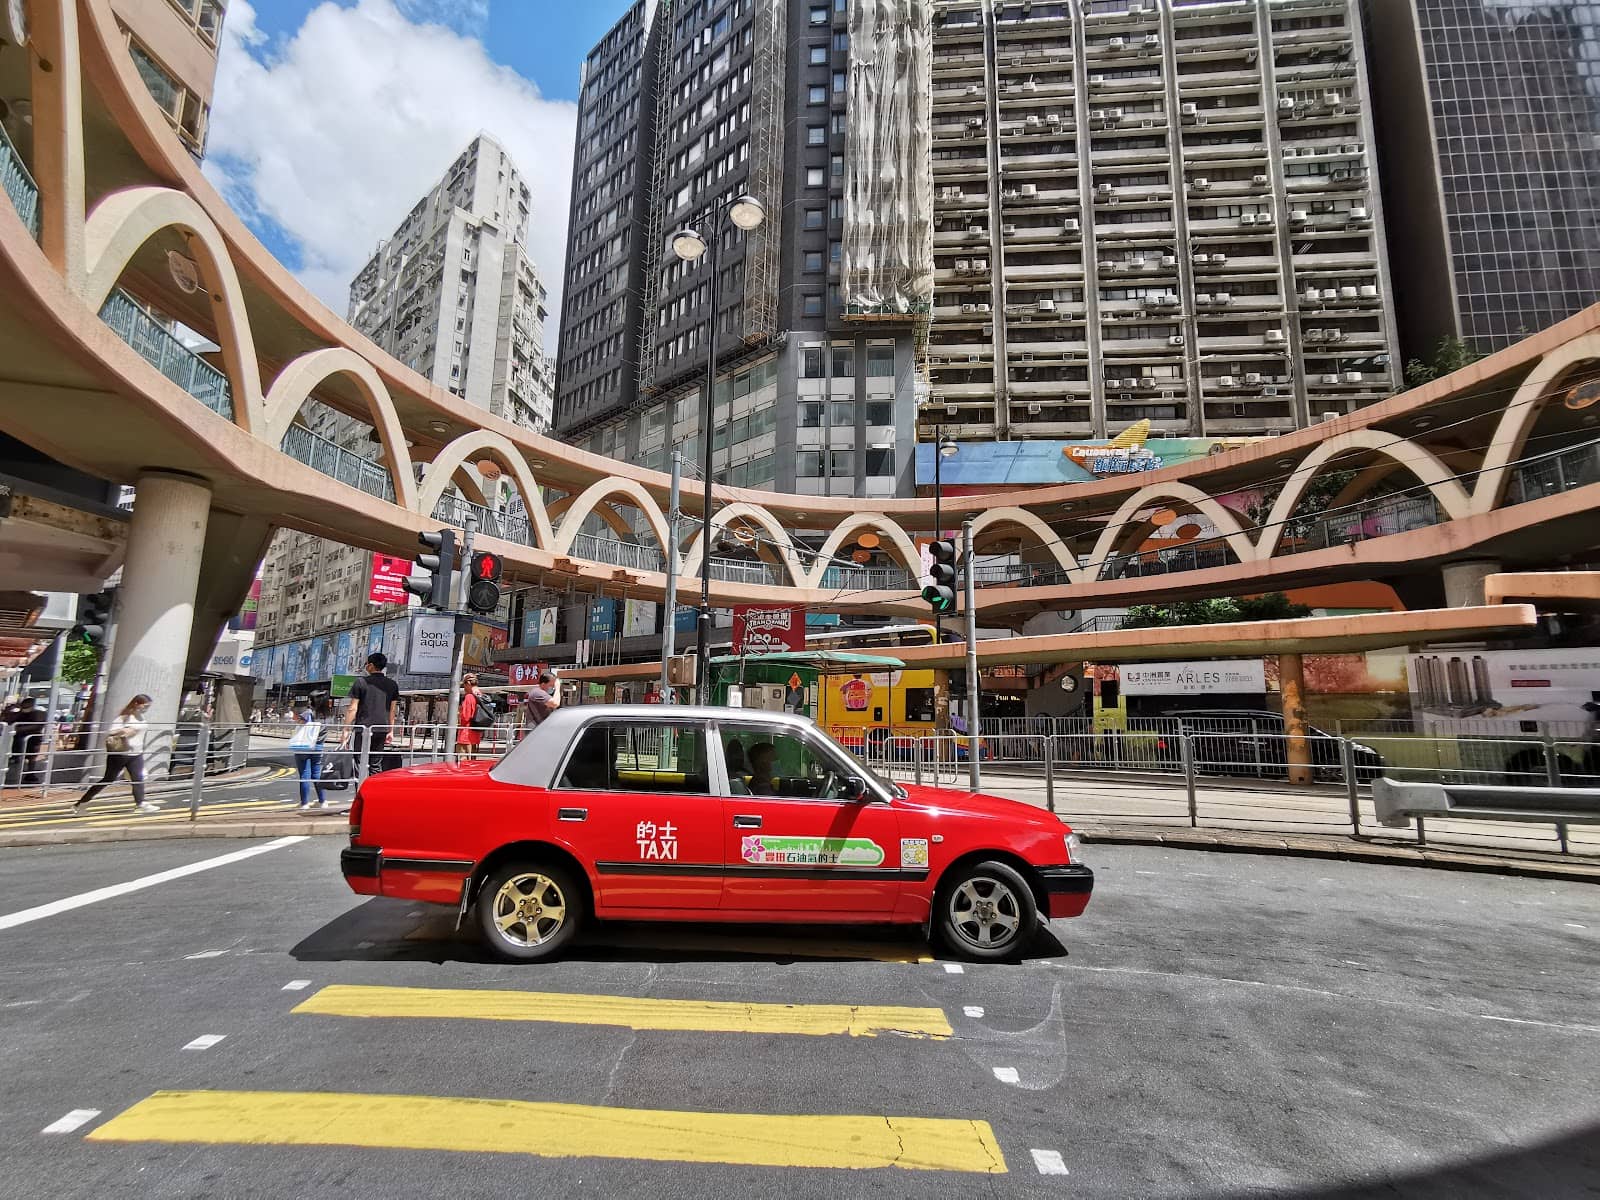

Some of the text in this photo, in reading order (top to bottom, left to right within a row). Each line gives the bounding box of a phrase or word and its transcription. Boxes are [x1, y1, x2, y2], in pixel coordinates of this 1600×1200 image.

[421, 629, 443, 640] bon
[420, 639, 449, 649] aqua
[1176, 671, 1220, 684] ARLES
[636, 820, 678, 840] 的士
[636, 839, 678, 860] TAXI
